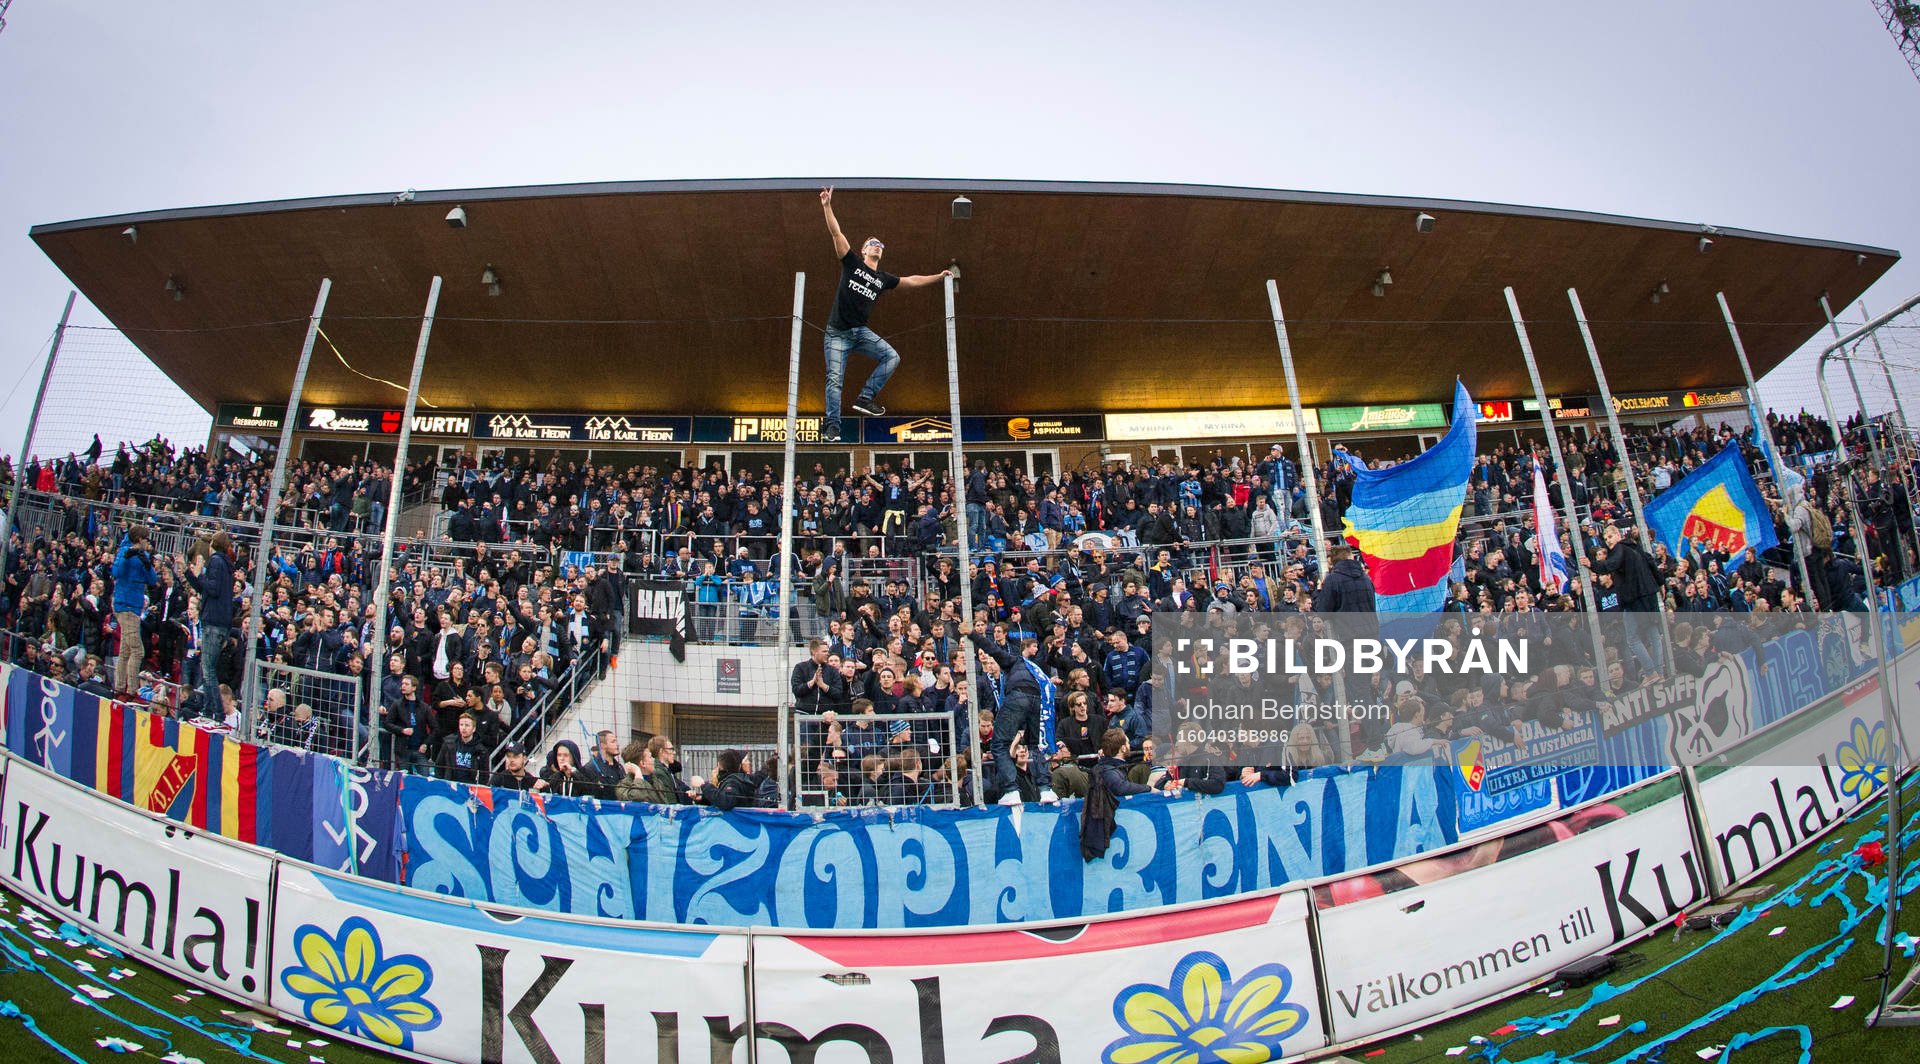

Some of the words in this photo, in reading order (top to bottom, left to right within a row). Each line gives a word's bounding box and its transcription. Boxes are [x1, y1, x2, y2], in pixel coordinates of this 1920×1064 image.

[848, 280, 877, 301] TECHNO
[1621, 397, 1669, 410] COLEMONT
[499, 427, 513, 438] AB
[515, 428, 538, 439] KARL
[541, 429, 571, 439] HEDIN
[596, 431, 611, 440] AB
[614, 431, 638, 441] KARL
[642, 431, 673, 441] HEDIN
[760, 431, 819, 441] PRODKTER
[1603, 688, 1650, 731] ANTI
[1486, 753, 1512, 771] MED
[1515, 747, 1530, 763] DE
[1532, 727, 1594, 756] AVSTÄNGDA
[1489, 770, 1527, 792] ULTRA
[1531, 761, 1558, 778] CAOS
[1560, 749, 1598, 771] STHLM
[411, 758, 1458, 928] SCHIZOPHRENIA
[12, 801, 260, 993] Kumla!
[1336, 933, 1551, 1018] Välkommen
[1558, 906, 1595, 945] till
[475, 944, 1059, 1064] Kumla
